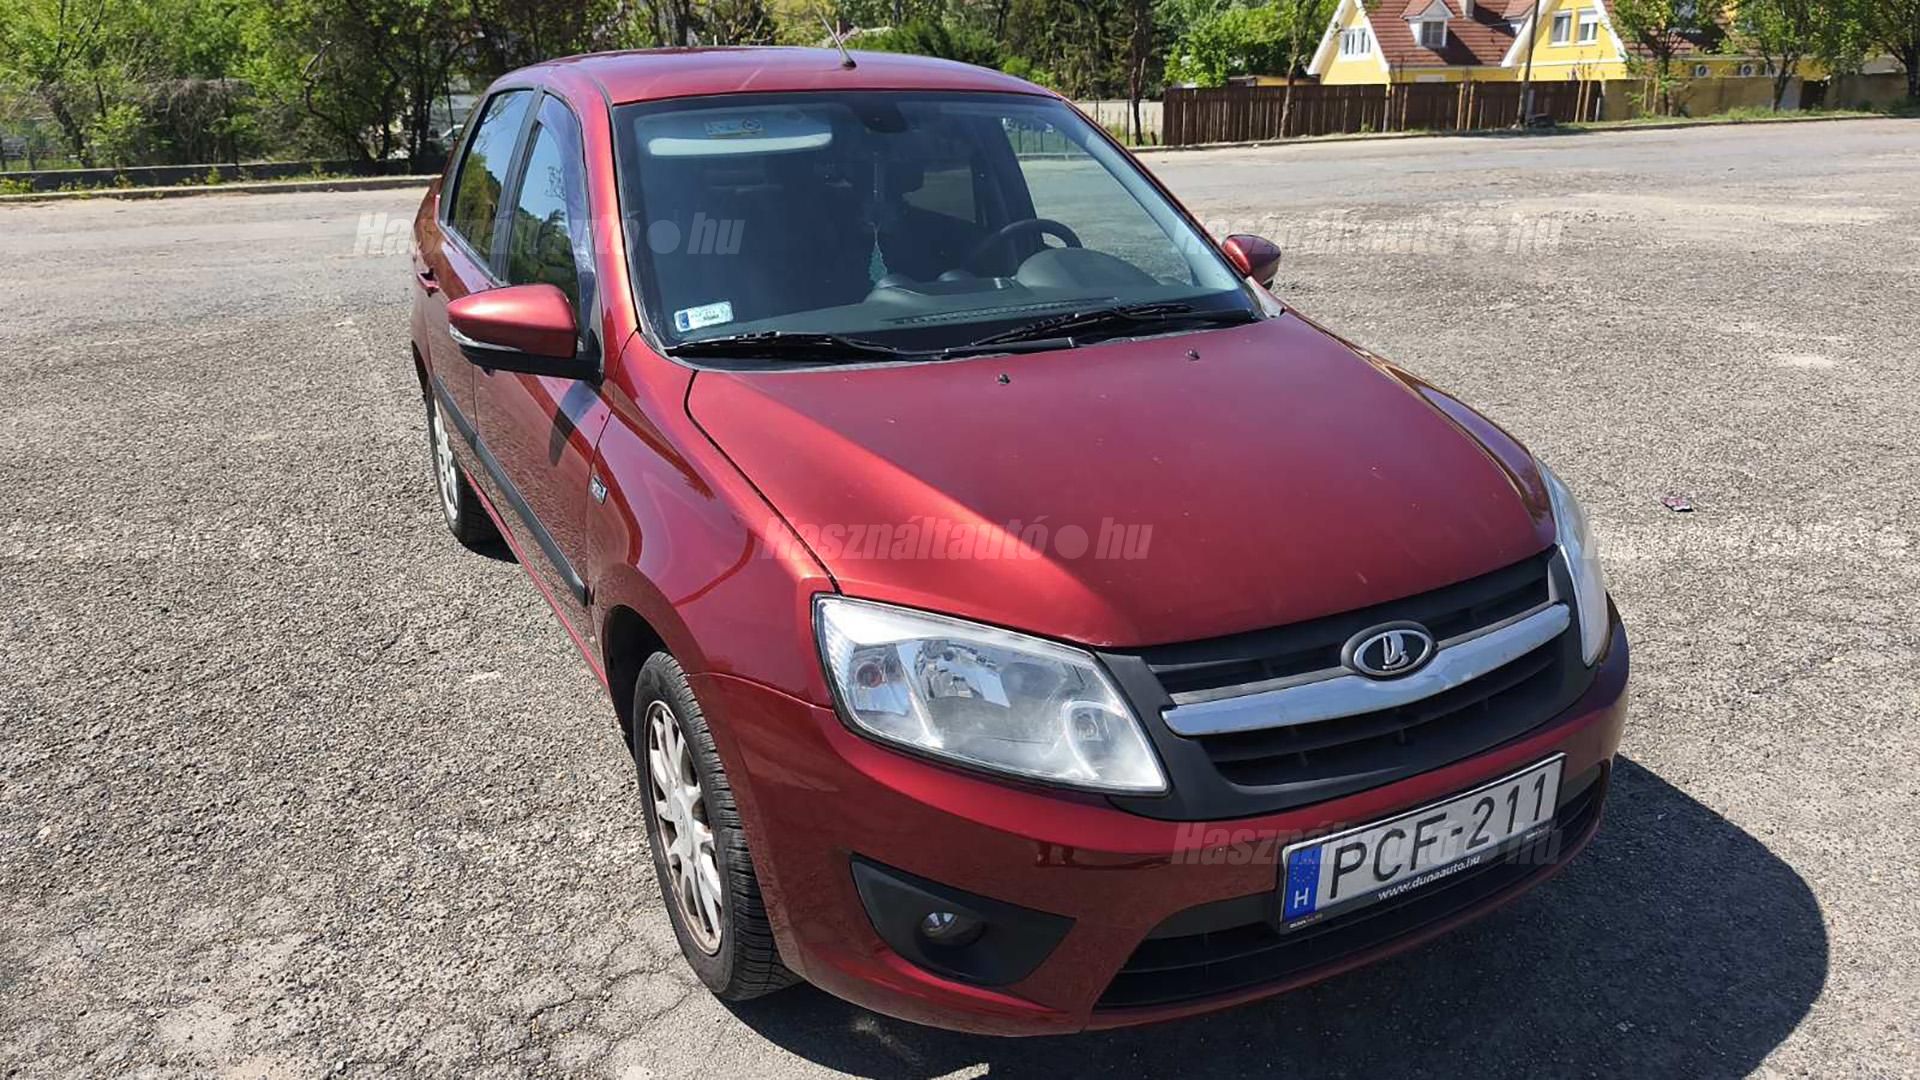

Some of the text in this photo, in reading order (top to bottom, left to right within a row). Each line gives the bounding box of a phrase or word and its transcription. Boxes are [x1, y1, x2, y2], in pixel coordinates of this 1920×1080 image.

[1328, 773, 1547, 899] PCF-211
[1293, 887, 1310, 909] H
[1377, 855, 1481, 901] www.dunaauto.hu
